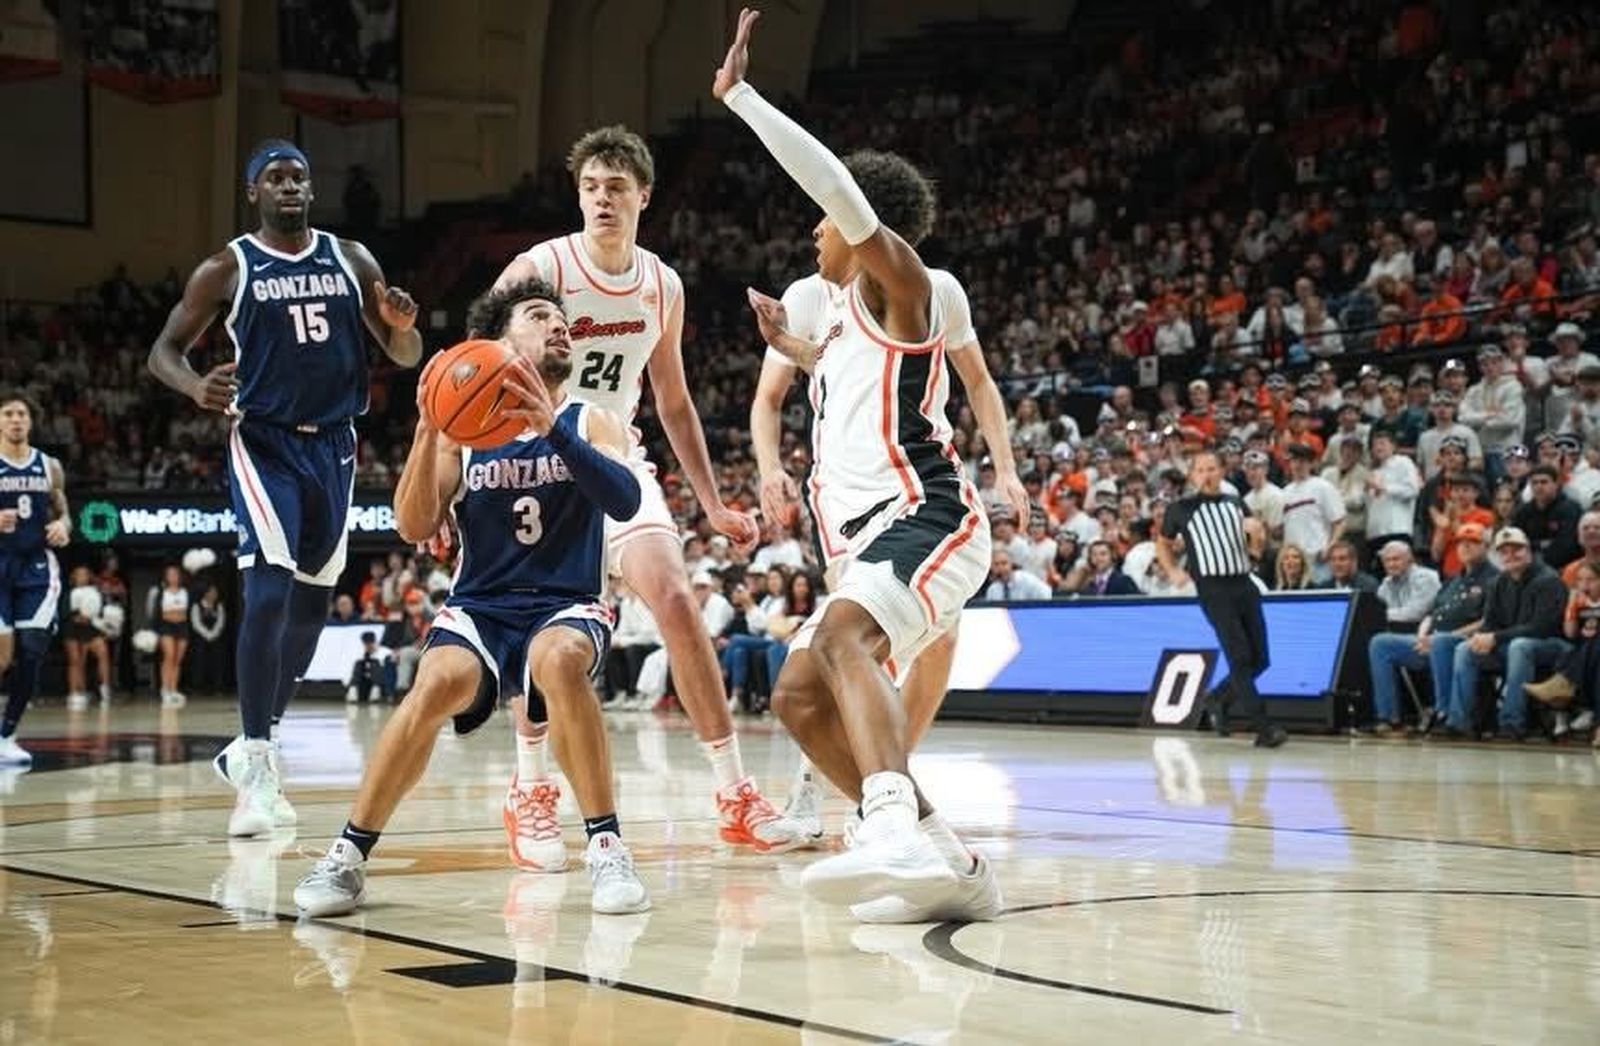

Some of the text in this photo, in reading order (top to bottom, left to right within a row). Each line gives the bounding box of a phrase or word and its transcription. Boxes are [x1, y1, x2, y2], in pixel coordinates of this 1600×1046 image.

[252, 272, 350, 302] GONZAGA
[288, 303, 329, 344] 15
[569, 316, 646, 340] Beavers
[578, 350, 624, 392] 24
[468, 453, 575, 492] GONZAG
[18, 494, 32, 519] 8
[120, 507, 239, 534] WaFdBank
[513, 495, 543, 545] 3
[1151, 652, 1206, 724] 0
